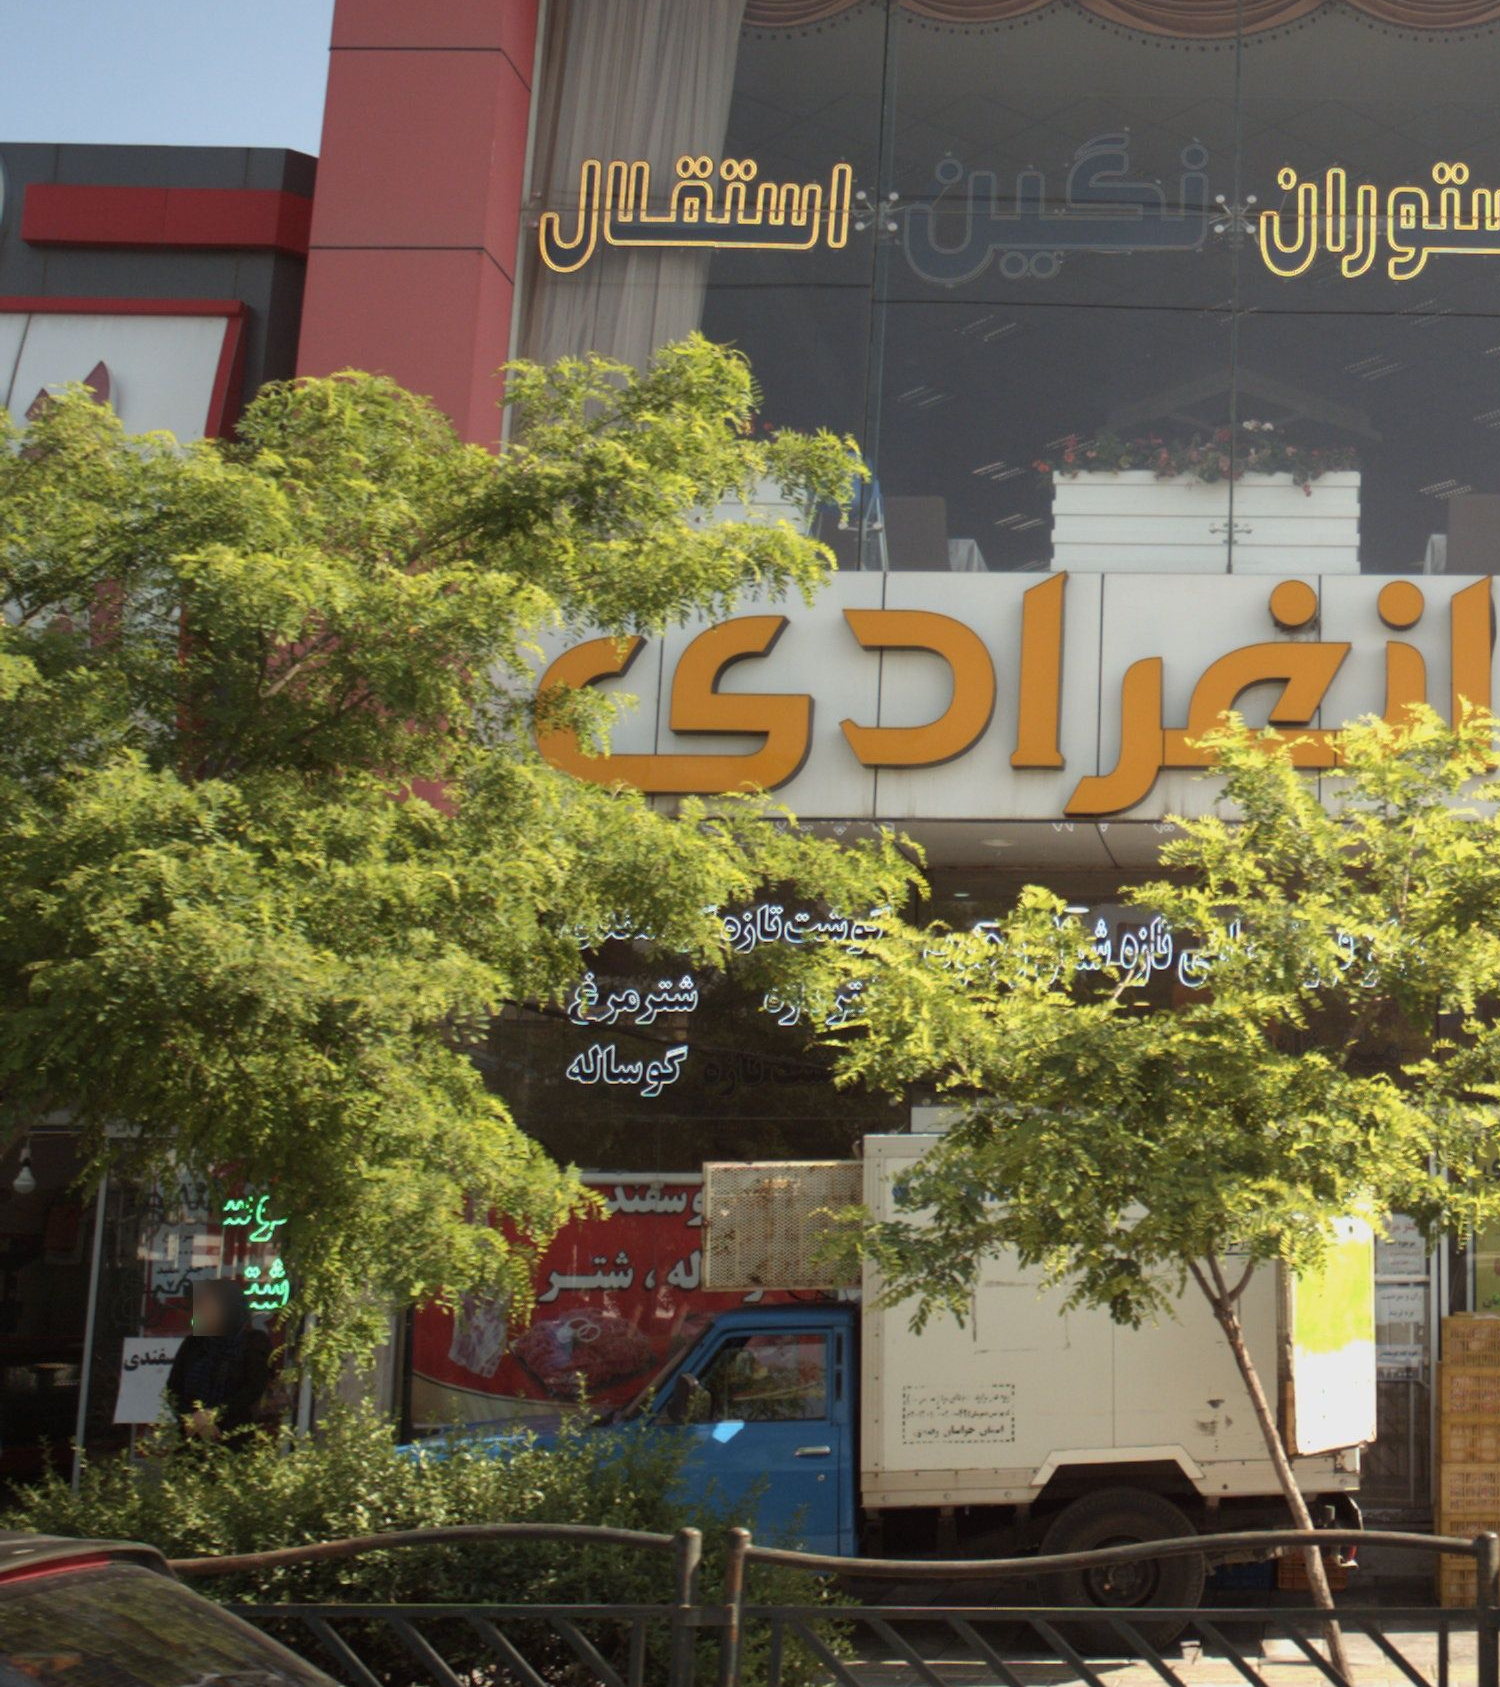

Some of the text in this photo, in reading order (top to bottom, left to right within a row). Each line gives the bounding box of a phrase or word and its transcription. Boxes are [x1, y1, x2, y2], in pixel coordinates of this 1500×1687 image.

[538, 155, 853, 274] استقلال
[533, 571, 1495, 816] انفرادی
[721, 903, 784, 954] تازه
[566, 1044, 689, 1098] گوساله
[536, 1251, 634, 1302] شتر
